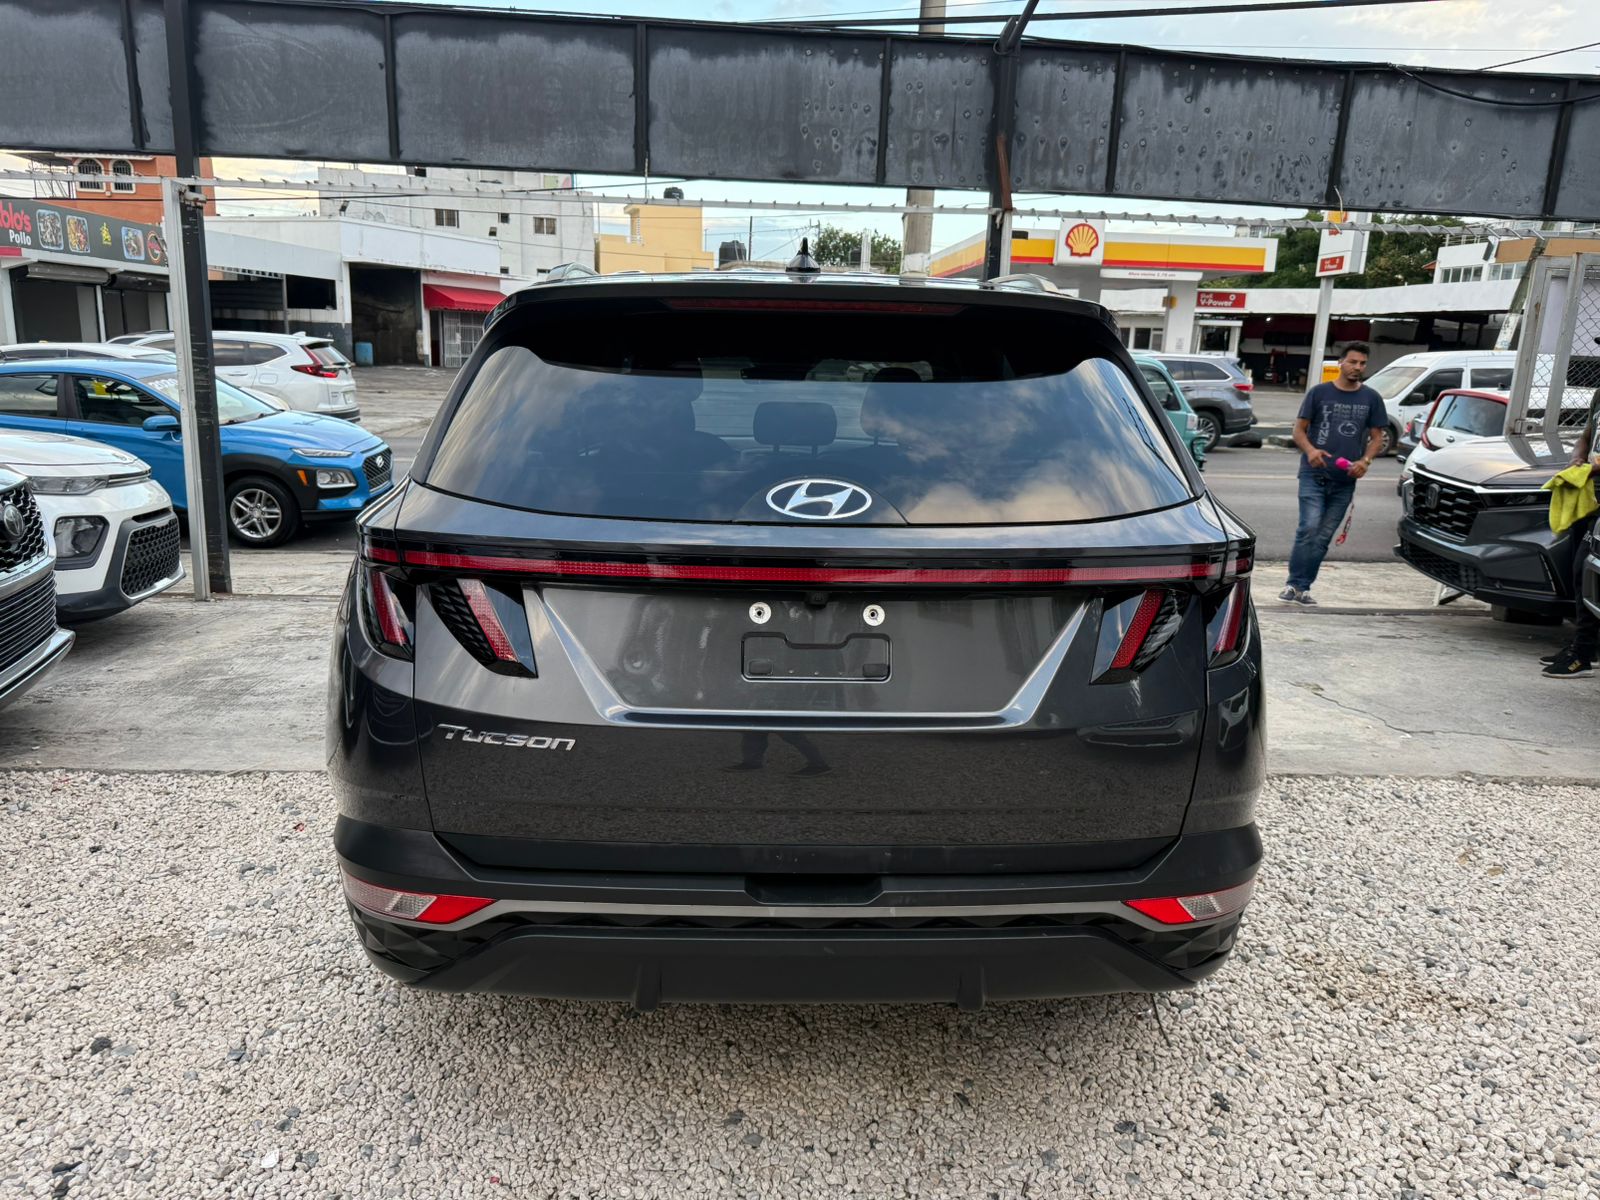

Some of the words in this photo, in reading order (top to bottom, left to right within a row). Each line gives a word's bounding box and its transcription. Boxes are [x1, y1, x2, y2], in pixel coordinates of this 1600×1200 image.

[9, 229, 31, 245] Pollo
[1200, 298, 1233, 307] V-Power
[1317, 405, 1332, 445] LIONS
